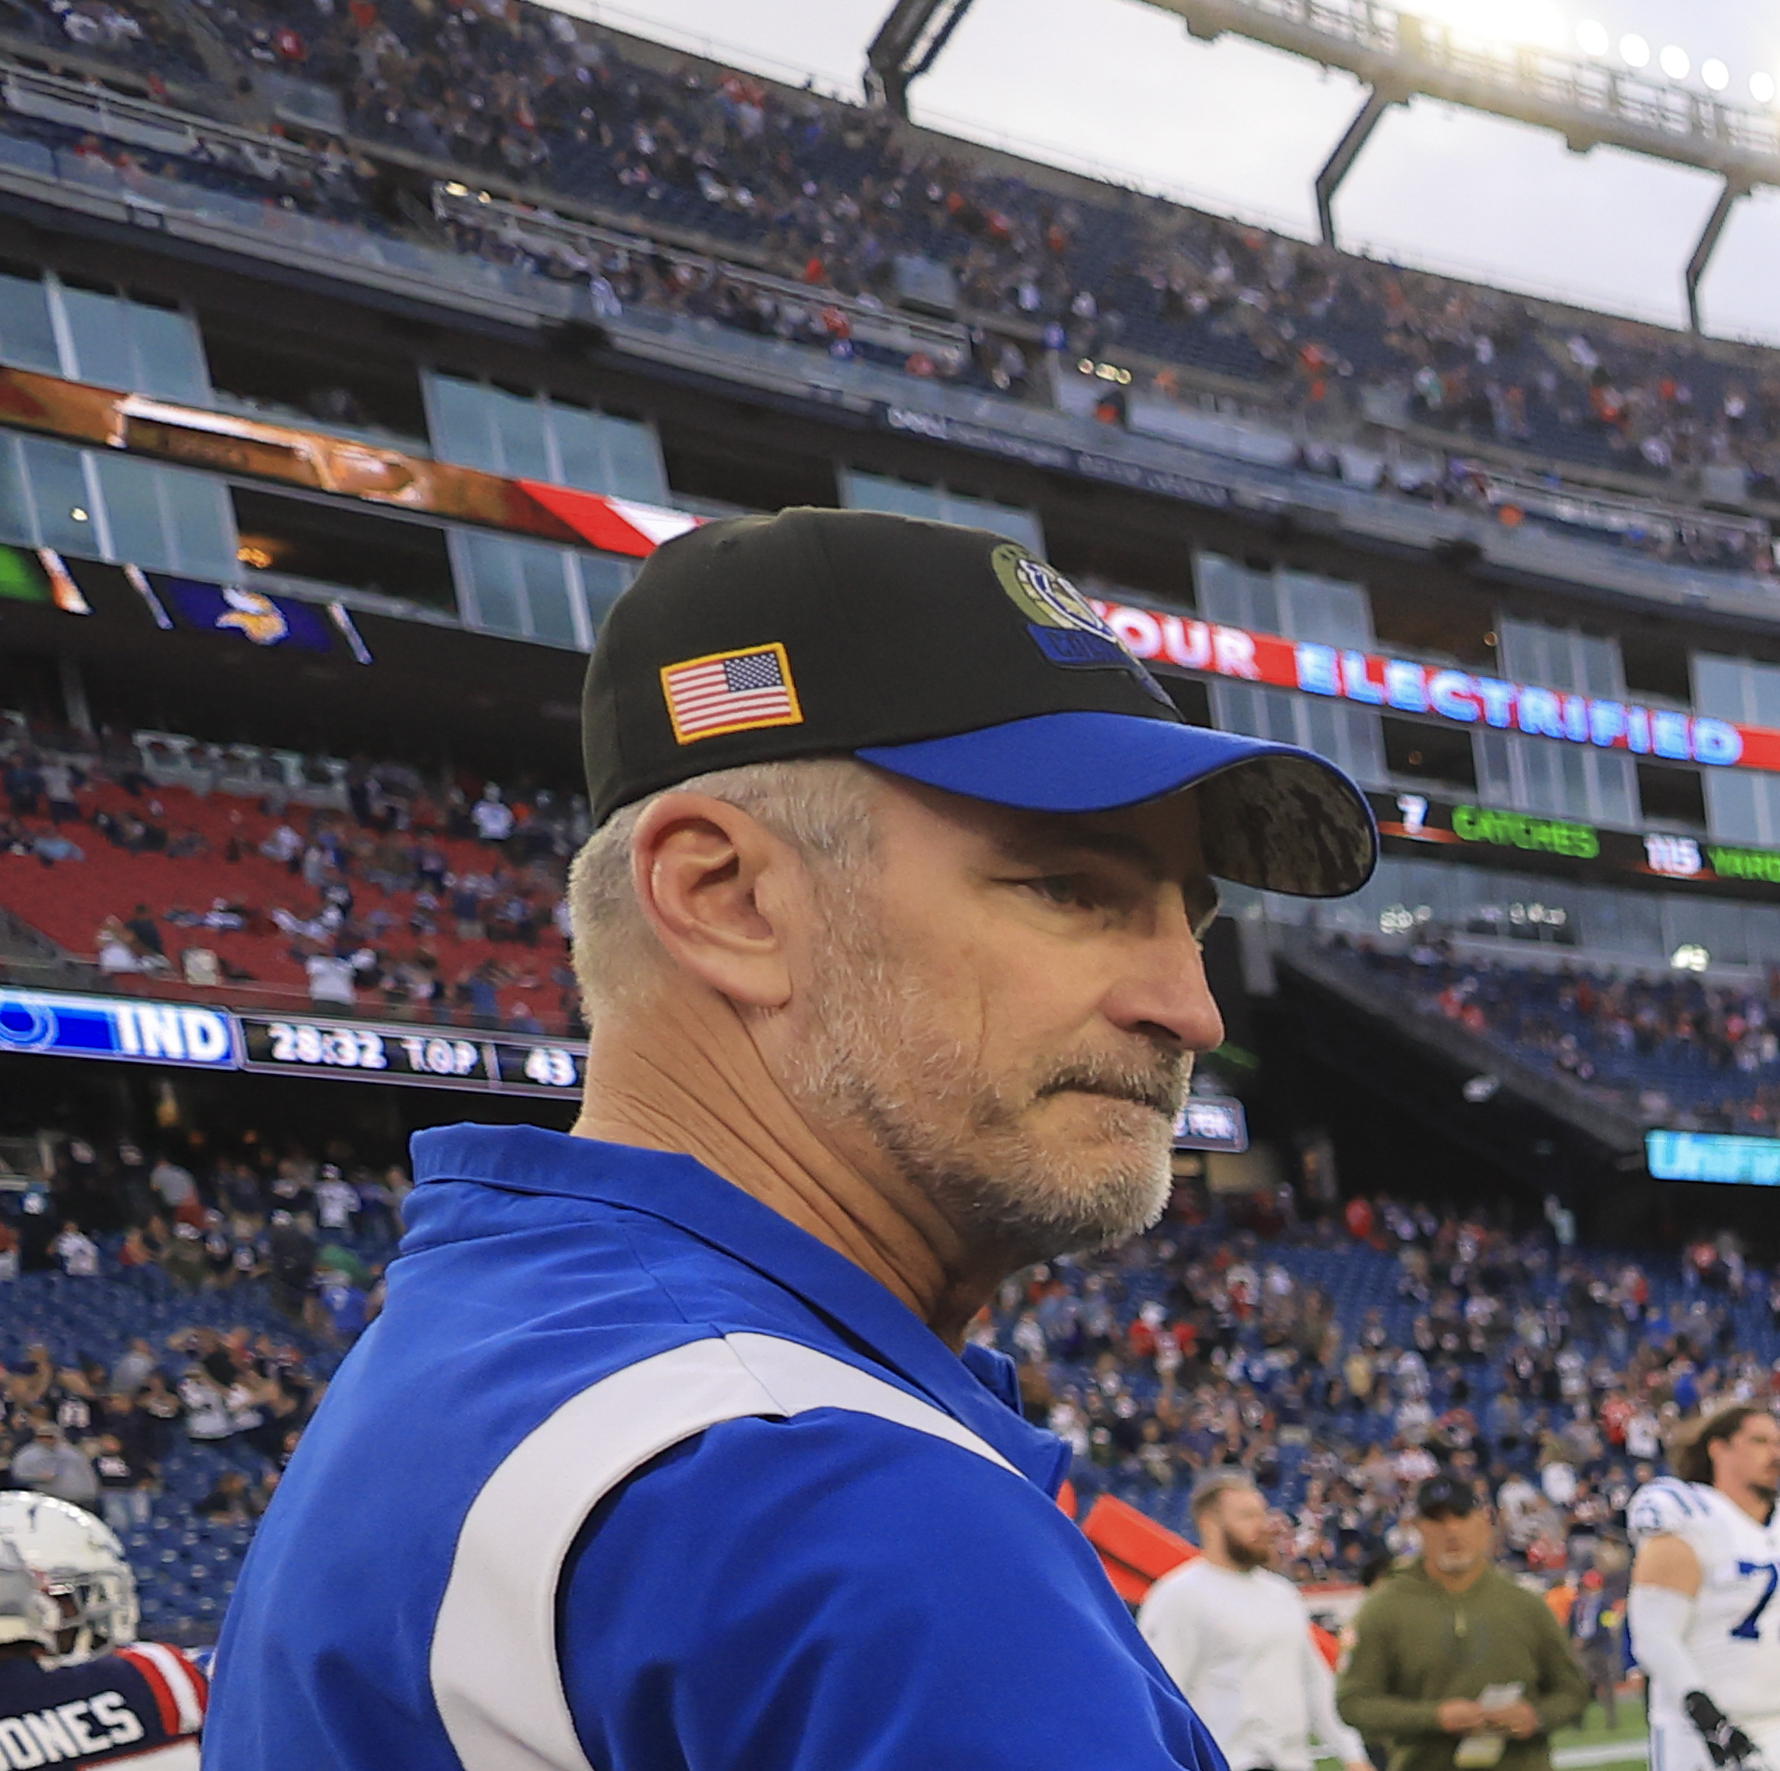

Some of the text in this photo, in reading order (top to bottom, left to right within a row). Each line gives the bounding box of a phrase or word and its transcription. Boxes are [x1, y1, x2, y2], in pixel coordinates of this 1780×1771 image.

[1294, 641, 1744, 766] ELECTRIFIED
[1452, 803, 1600, 860] CATCHES
[114, 1001, 230, 1063] IND
[267, 1021, 389, 1069] 28:32
